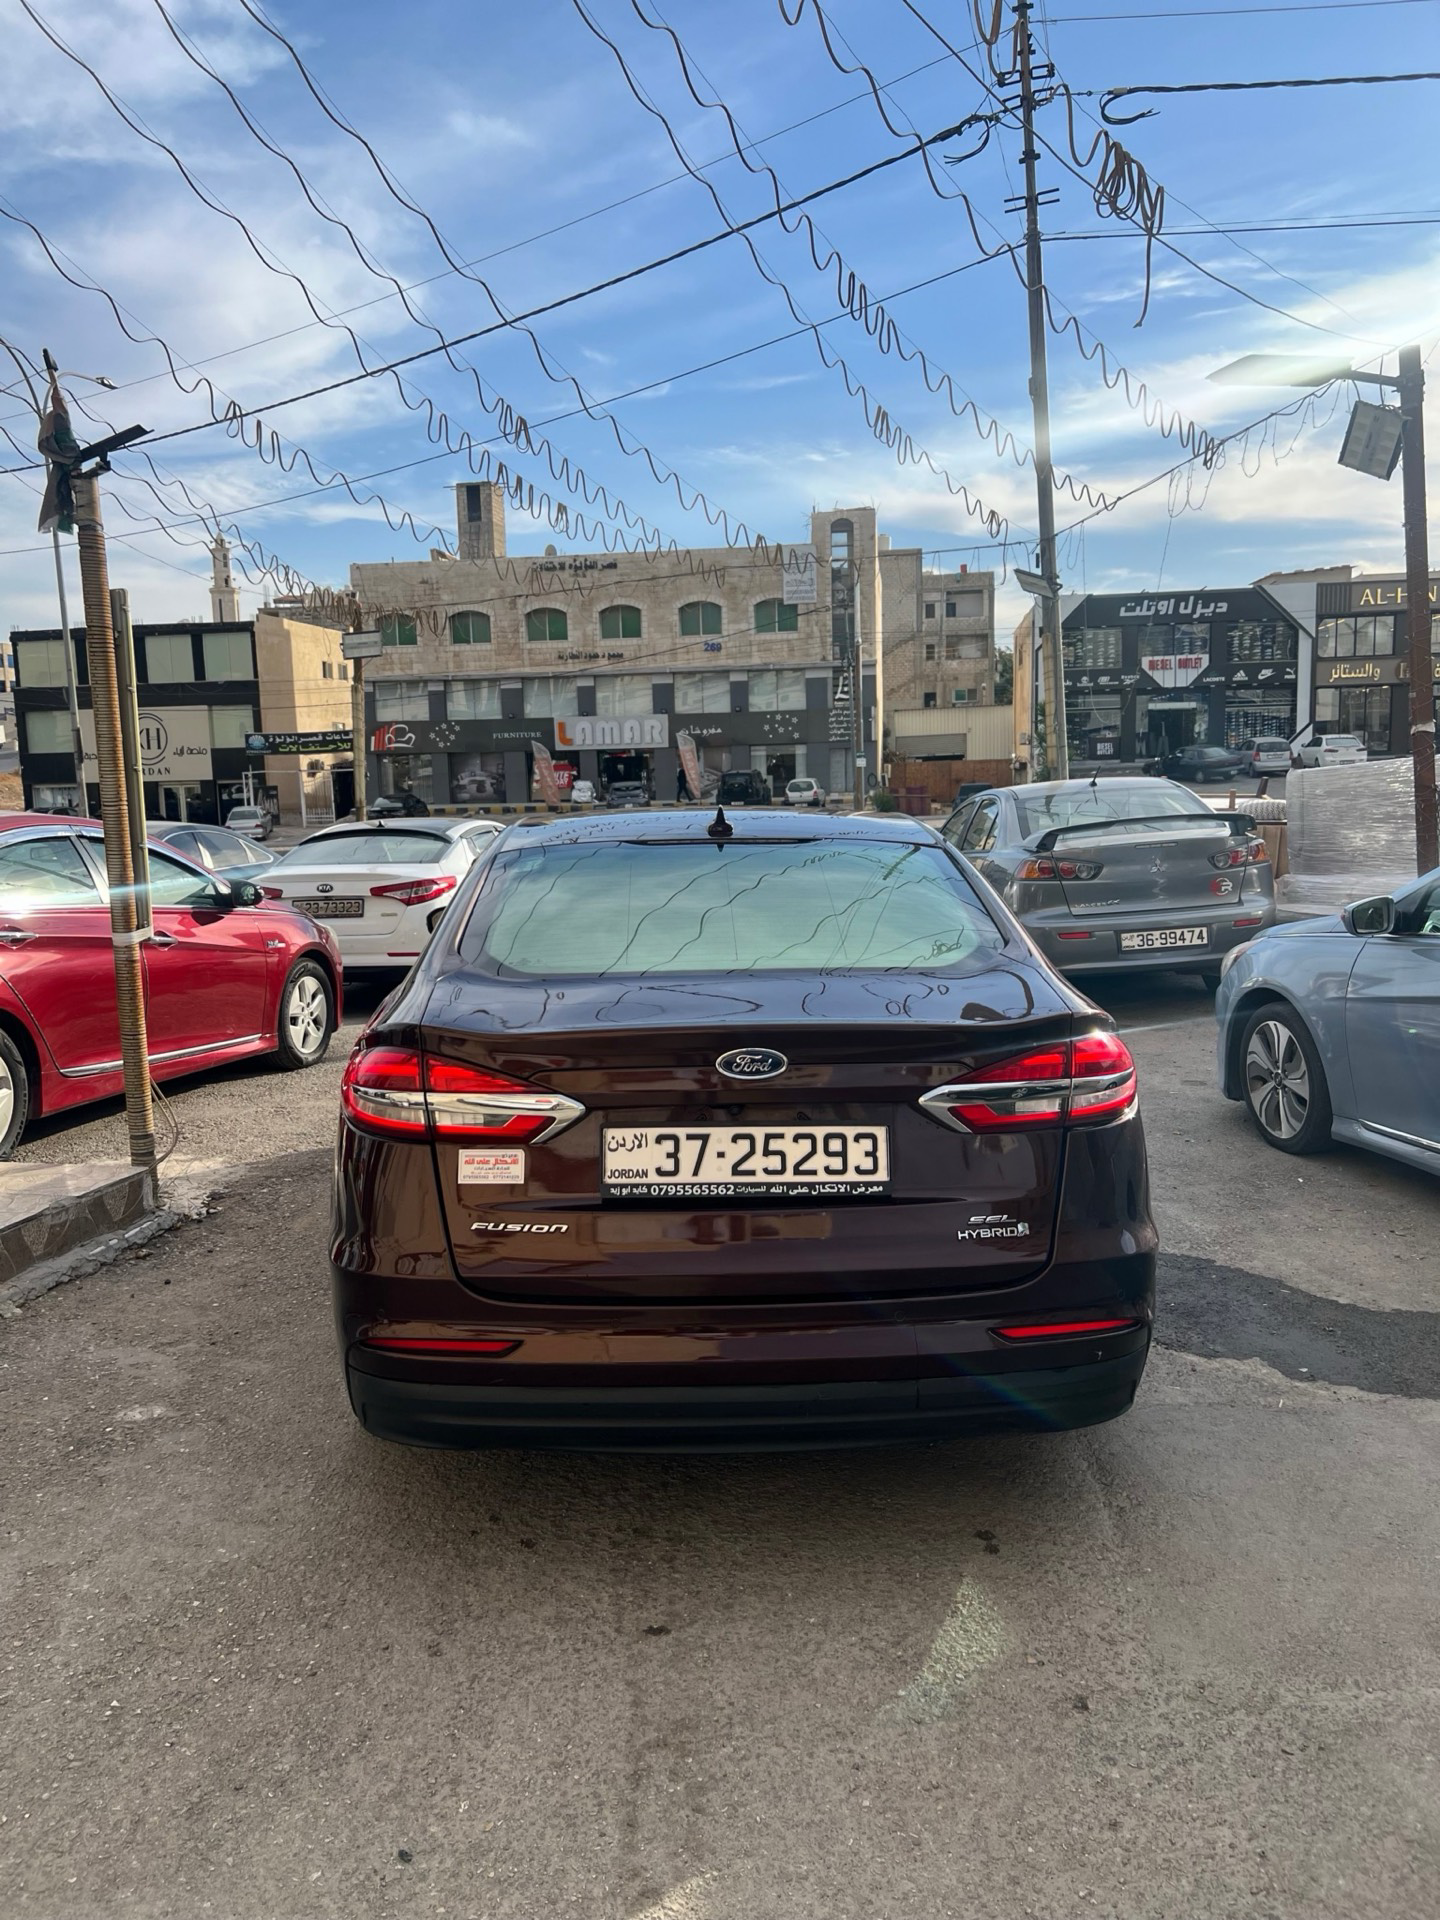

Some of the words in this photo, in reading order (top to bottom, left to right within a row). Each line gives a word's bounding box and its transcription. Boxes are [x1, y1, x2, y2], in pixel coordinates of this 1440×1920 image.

[1120, 599, 1176, 617] اوتلت
[1179, 595, 1229, 618] ديزل
[704, 643, 723, 652] 269
[1178, 657, 1203, 670] OUTLET
[1329, 663, 1380, 683] والستائر
[492, 731, 542, 739] FURNITURE
[557, 719, 664, 746] LAMAR
[318, 884, 332, 892] KIA
[304, 901, 361, 914] 23-73323
[1136, 928, 1205, 948] 36-99474
[732, 1054, 773, 1073] Ford
[607, 1132, 649, 1152] الاردن
[655, 1132, 878, 1177] 37-25293
[607, 1169, 649, 1180] JORDAN
[610, 1186, 620, 1196] زيد
[621, 1185, 631, 1196] ابو
[632, 1185, 648, 1195] كايد
[651, 1184, 735, 1196] 0795565562
[736, 1185, 766, 1194] للسيارات
[770, 1184, 787, 1193] الله
[789, 1184, 809, 1195] على
[811, 1184, 850, 1195] الاتكال
[852, 1183, 883, 1195] معرض
[968, 1214, 1017, 1224] SEL
[470, 1222, 569, 1233] FUSION
[957, 1227, 1018, 1240] HYBRID
